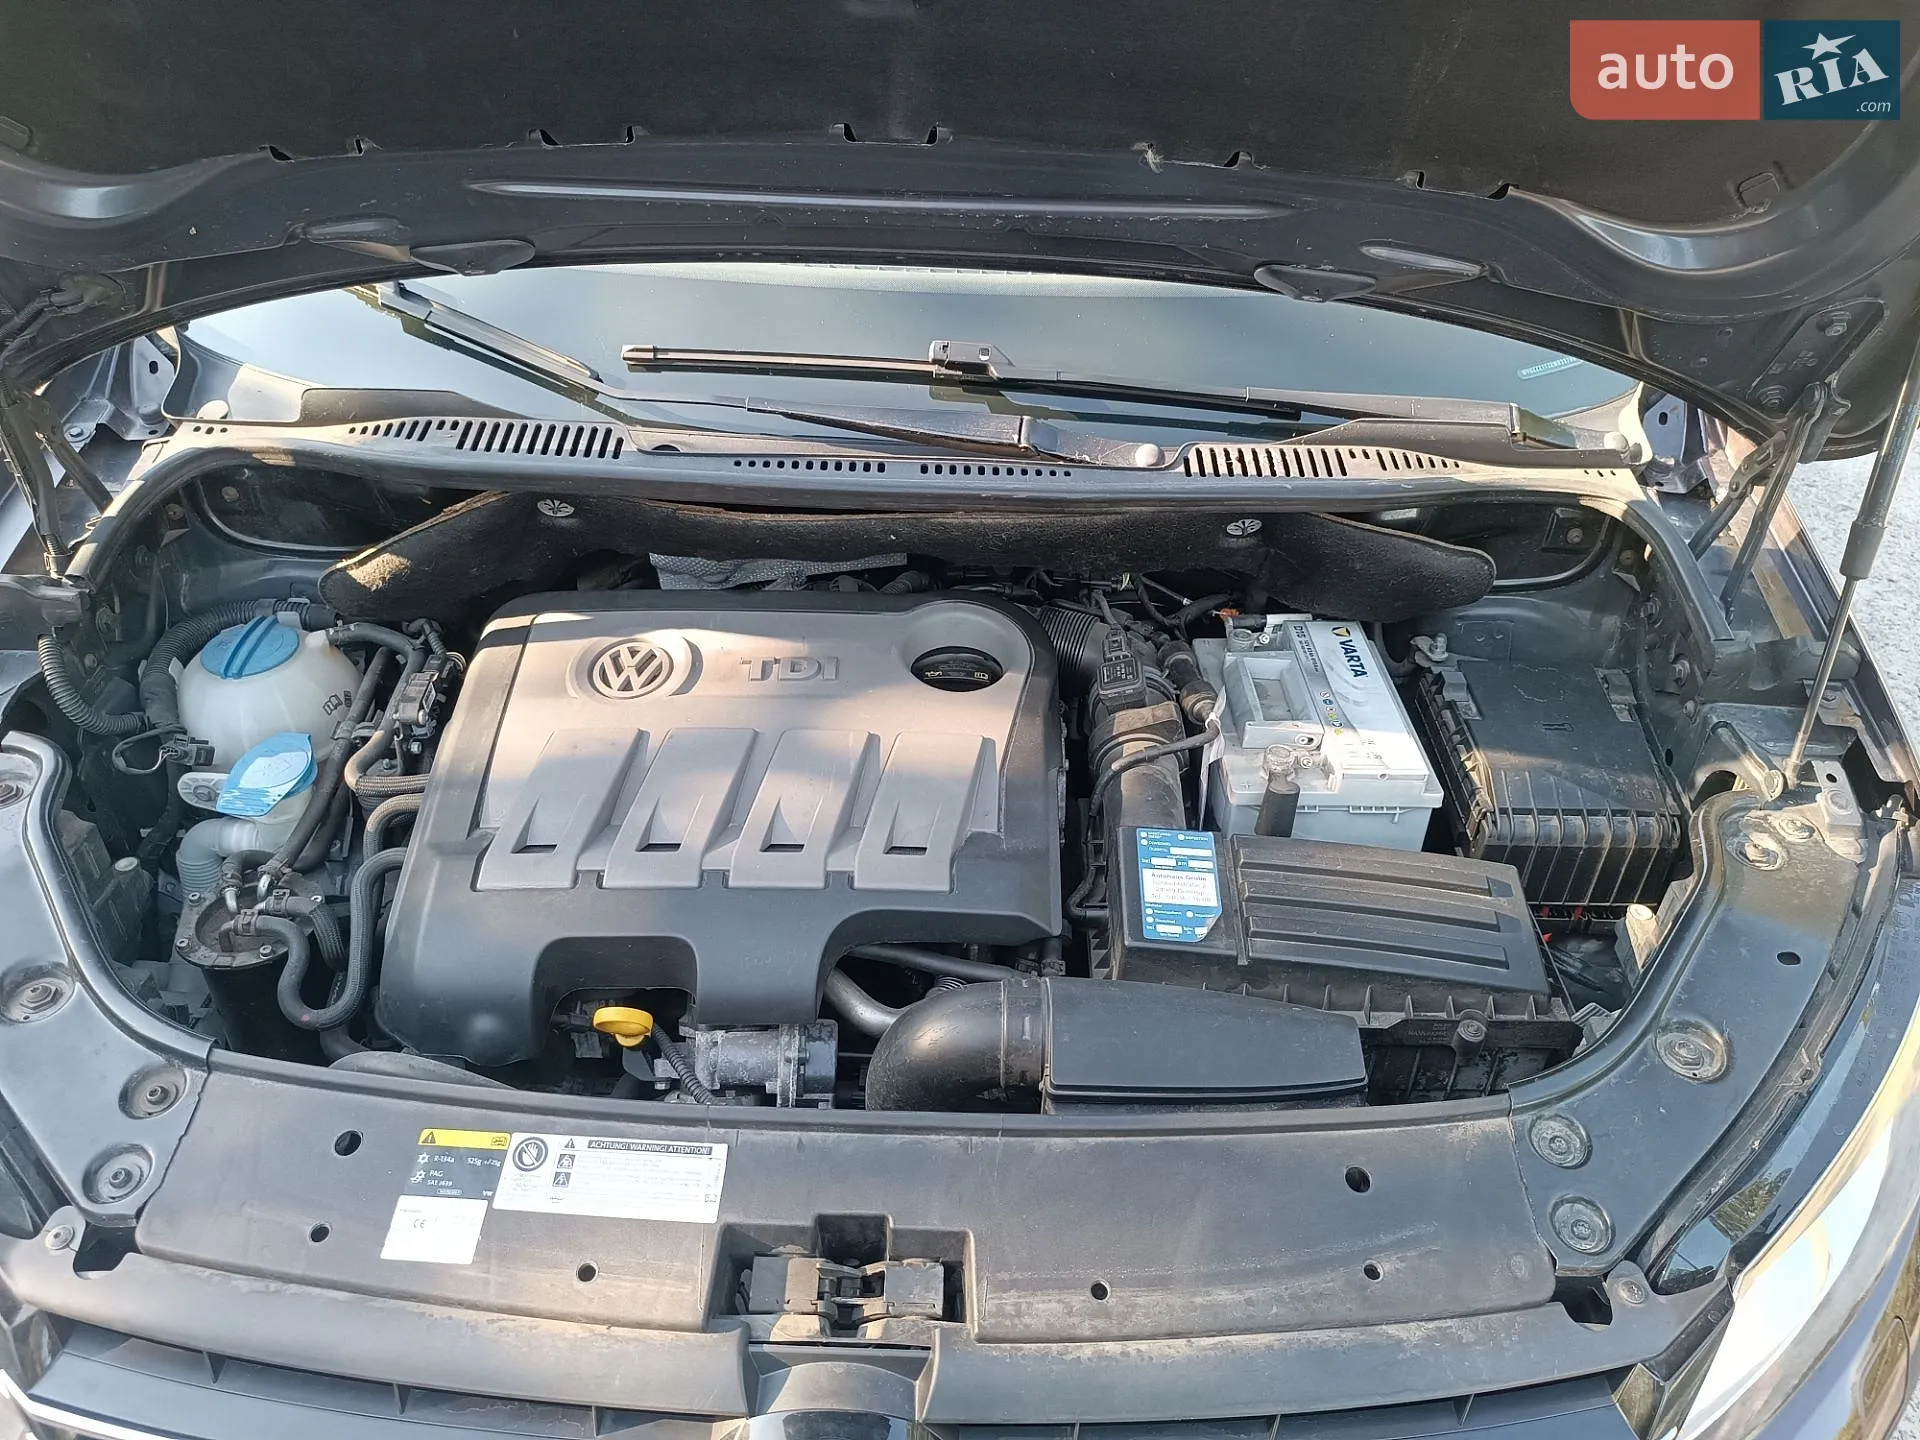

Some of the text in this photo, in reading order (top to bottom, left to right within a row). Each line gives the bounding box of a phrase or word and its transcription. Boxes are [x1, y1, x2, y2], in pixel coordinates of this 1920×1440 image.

[1339, 638, 1368, 678] VARTA
[740, 656, 840, 682] TDI
[590, 1140, 711, 1155] ACHTUNG! WARNING! ATTENTION!
[429, 1170, 444, 1178] PAG
